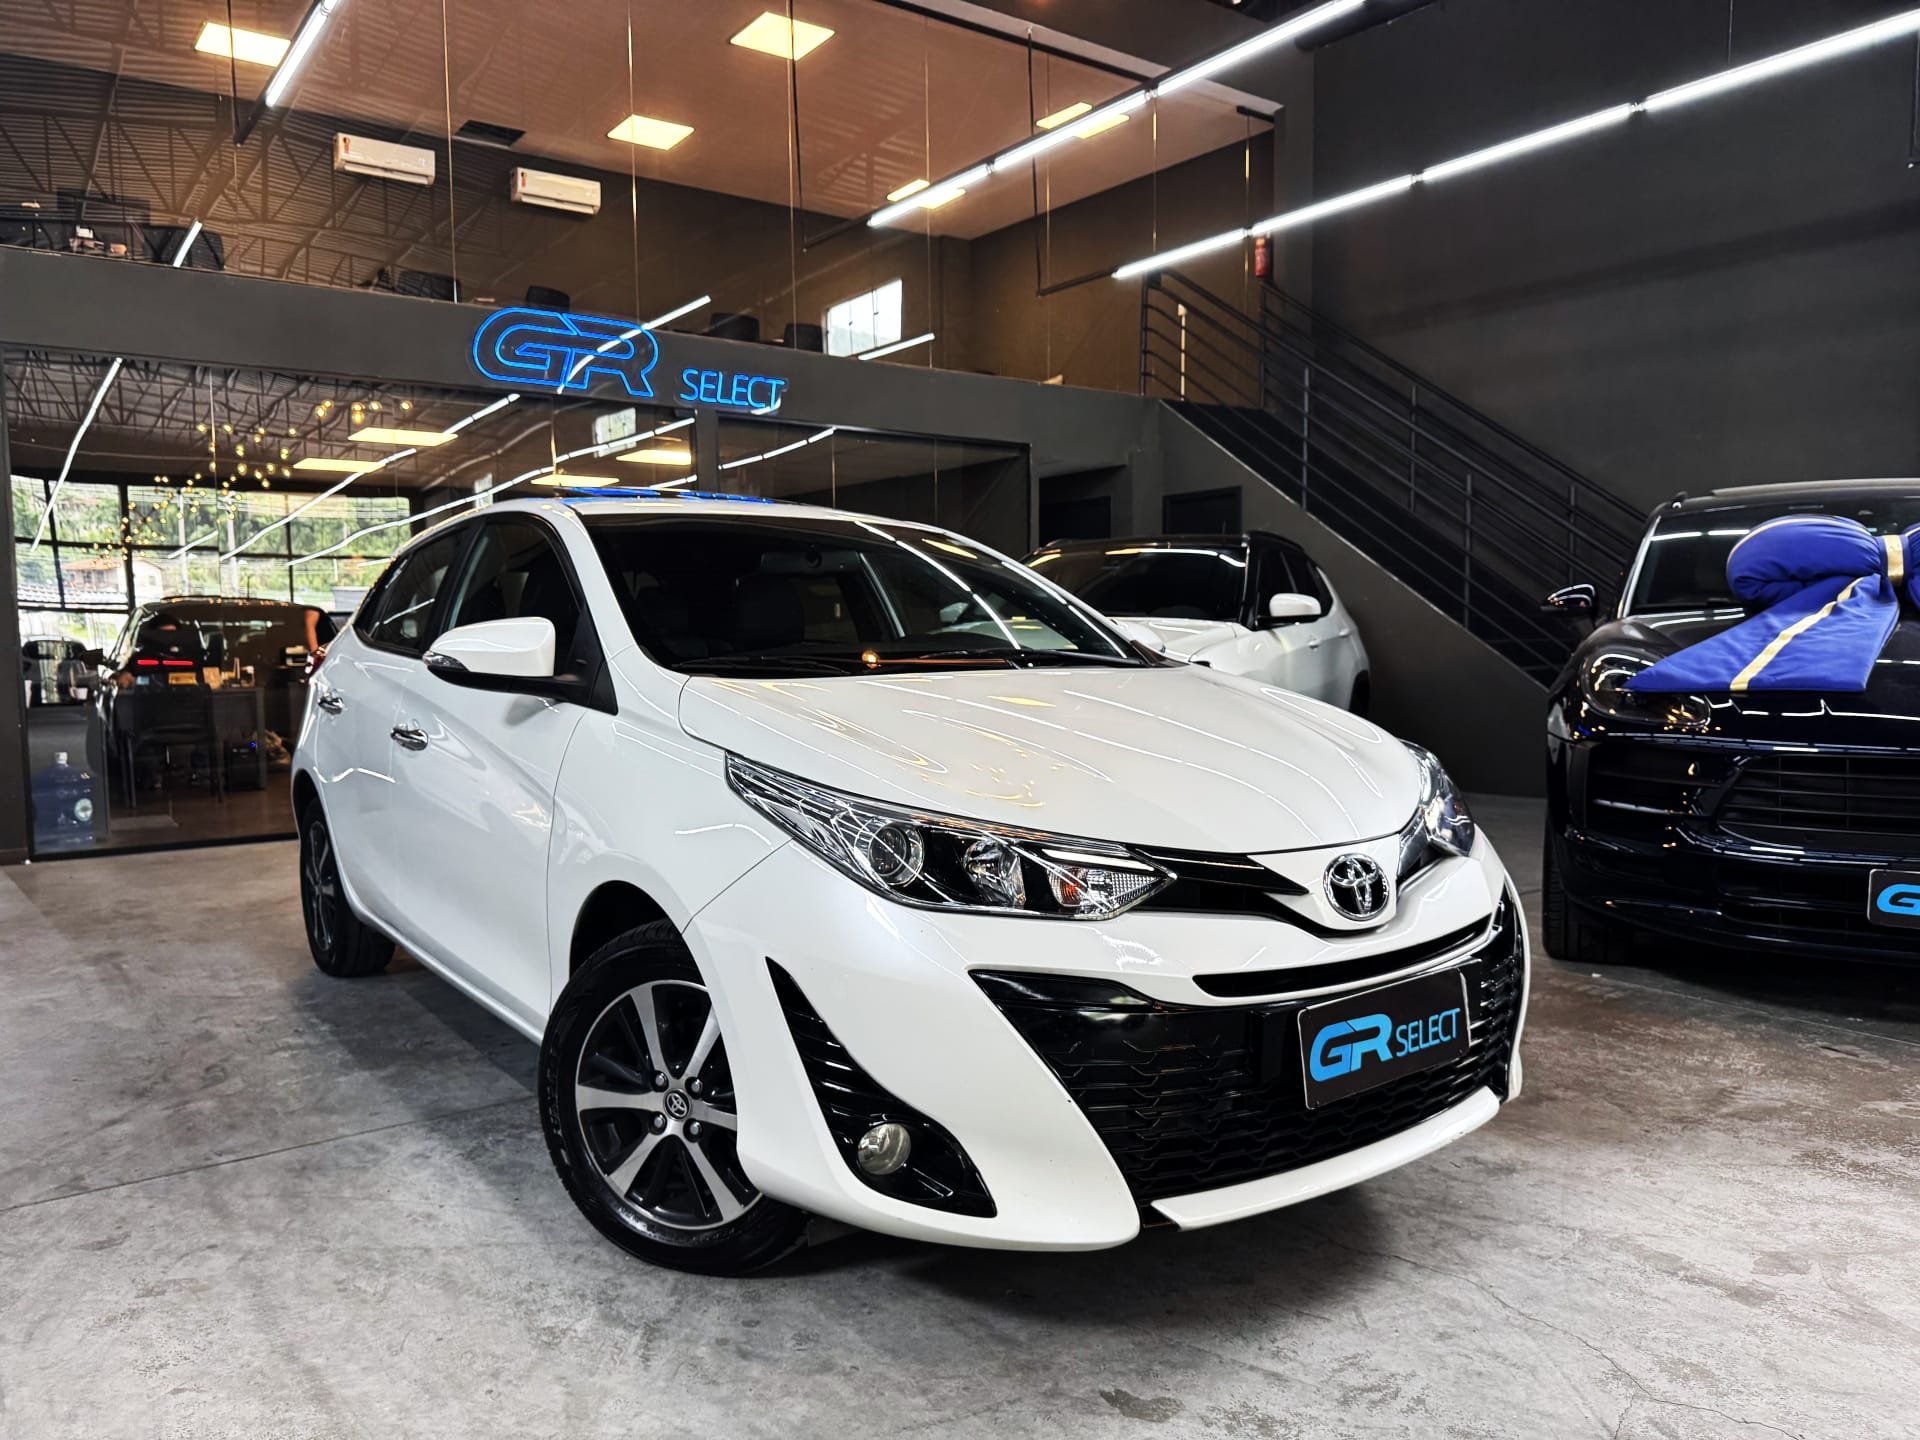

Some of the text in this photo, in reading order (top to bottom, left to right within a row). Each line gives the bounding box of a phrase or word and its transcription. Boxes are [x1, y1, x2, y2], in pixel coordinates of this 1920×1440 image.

[473, 307, 786, 410] GR SELECT
[1310, 1007, 1461, 1082] GR SELECT
